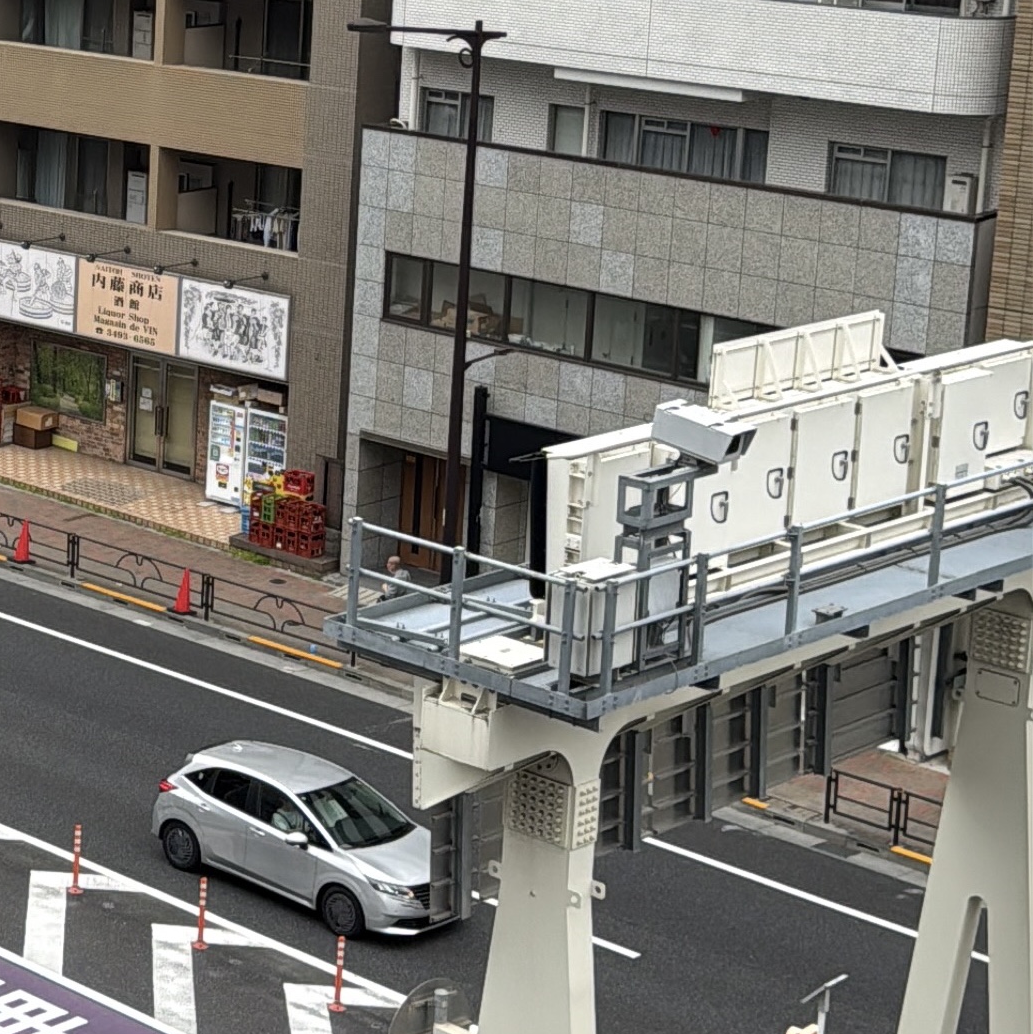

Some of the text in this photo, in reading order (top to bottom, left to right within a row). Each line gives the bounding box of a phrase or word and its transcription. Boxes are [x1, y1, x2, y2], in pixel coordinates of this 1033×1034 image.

[91, 272, 163, 302] 内藤商店
[97, 305, 150, 325] Liquor Shop
[129, 322, 140, 333] de
[142, 324, 158, 337] VIN
